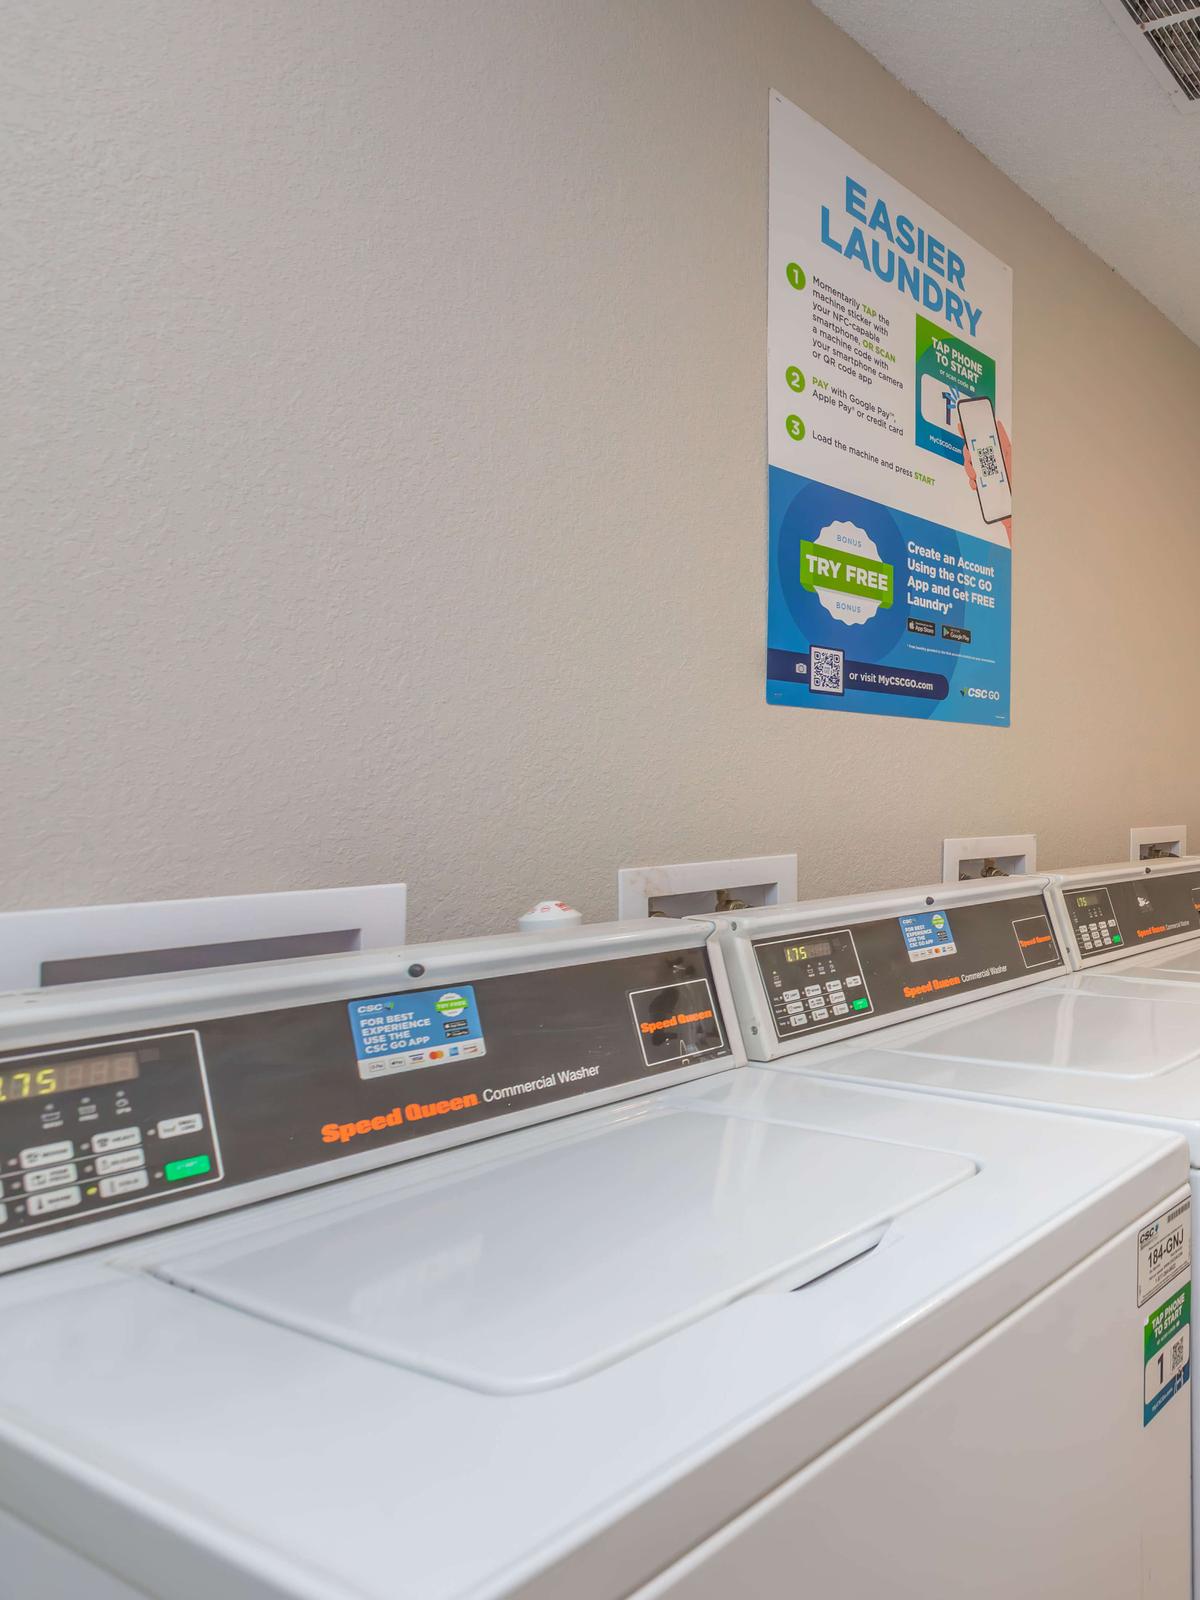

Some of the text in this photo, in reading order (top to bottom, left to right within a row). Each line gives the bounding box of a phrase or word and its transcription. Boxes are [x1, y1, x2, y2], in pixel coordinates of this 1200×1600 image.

[846, 175, 966, 292] EASIER
[793, 268, 799, 285] 1
[821, 205, 983, 338] LAUNDRY
[813, 275, 890, 326] Momentarily TAP the
[813, 289, 889, 337] machine sticker with
[812, 301, 880, 344] your NFC-capable
[813, 313, 896, 364] smartphone, OR SCAN
[812, 337, 904, 389] your smartphone camera
[813, 326, 889, 371] a machine code with
[931, 336, 983, 376] TAP PHONE
[791, 371, 801, 388] 2
[812, 350, 873, 385] or QR code app
[936, 351, 980, 384] TO START
[812, 376, 829, 391] PAY
[831, 385, 848, 400] with
[849, 393, 876, 413] Google
[791, 419, 801, 436] 3
[812, 389, 836, 406] Apple
[856, 409, 865, 418] or
[866, 414, 887, 430] credit
[888, 424, 904, 436] card
[812, 430, 936, 486] Load the machine and press START
[836, 534, 862, 548] BONUS
[805, 554, 889, 592] TRY FREE
[907, 541, 995, 578] Create an Account
[907, 557, 993, 592] Using the CSC GO
[836, 601, 862, 614] BONUS
[907, 575, 996, 609] App and Get FREE
[848, 671, 934, 691] or visit MyCSCGO.com
[967, 687, 1000, 701] CSC GO
[903, 964, 1008, 998] Speed Queen Commercial Washer
[357, 1003, 383, 1013] CSC
[360, 1012, 415, 1028] FOR BEST
[640, 1008, 713, 1034] Speed Queen
[361, 1018, 432, 1037] EXPERIENCE
[363, 1030, 411, 1046] USE THE
[365, 1035, 431, 1054] CSC GO APP
[321, 1064, 600, 1143] Speed Queen Commercial Washer
[1139, 1227, 1155, 1244] CSC
[1148, 1227, 1184, 1268] 184-GNJ
[1152, 1292, 1185, 1329] TAP PHONE
[1154, 1324, 1164, 1338] TO
[1164, 1305, 1183, 1330] START
[1157, 1352, 1164, 1385] 1
